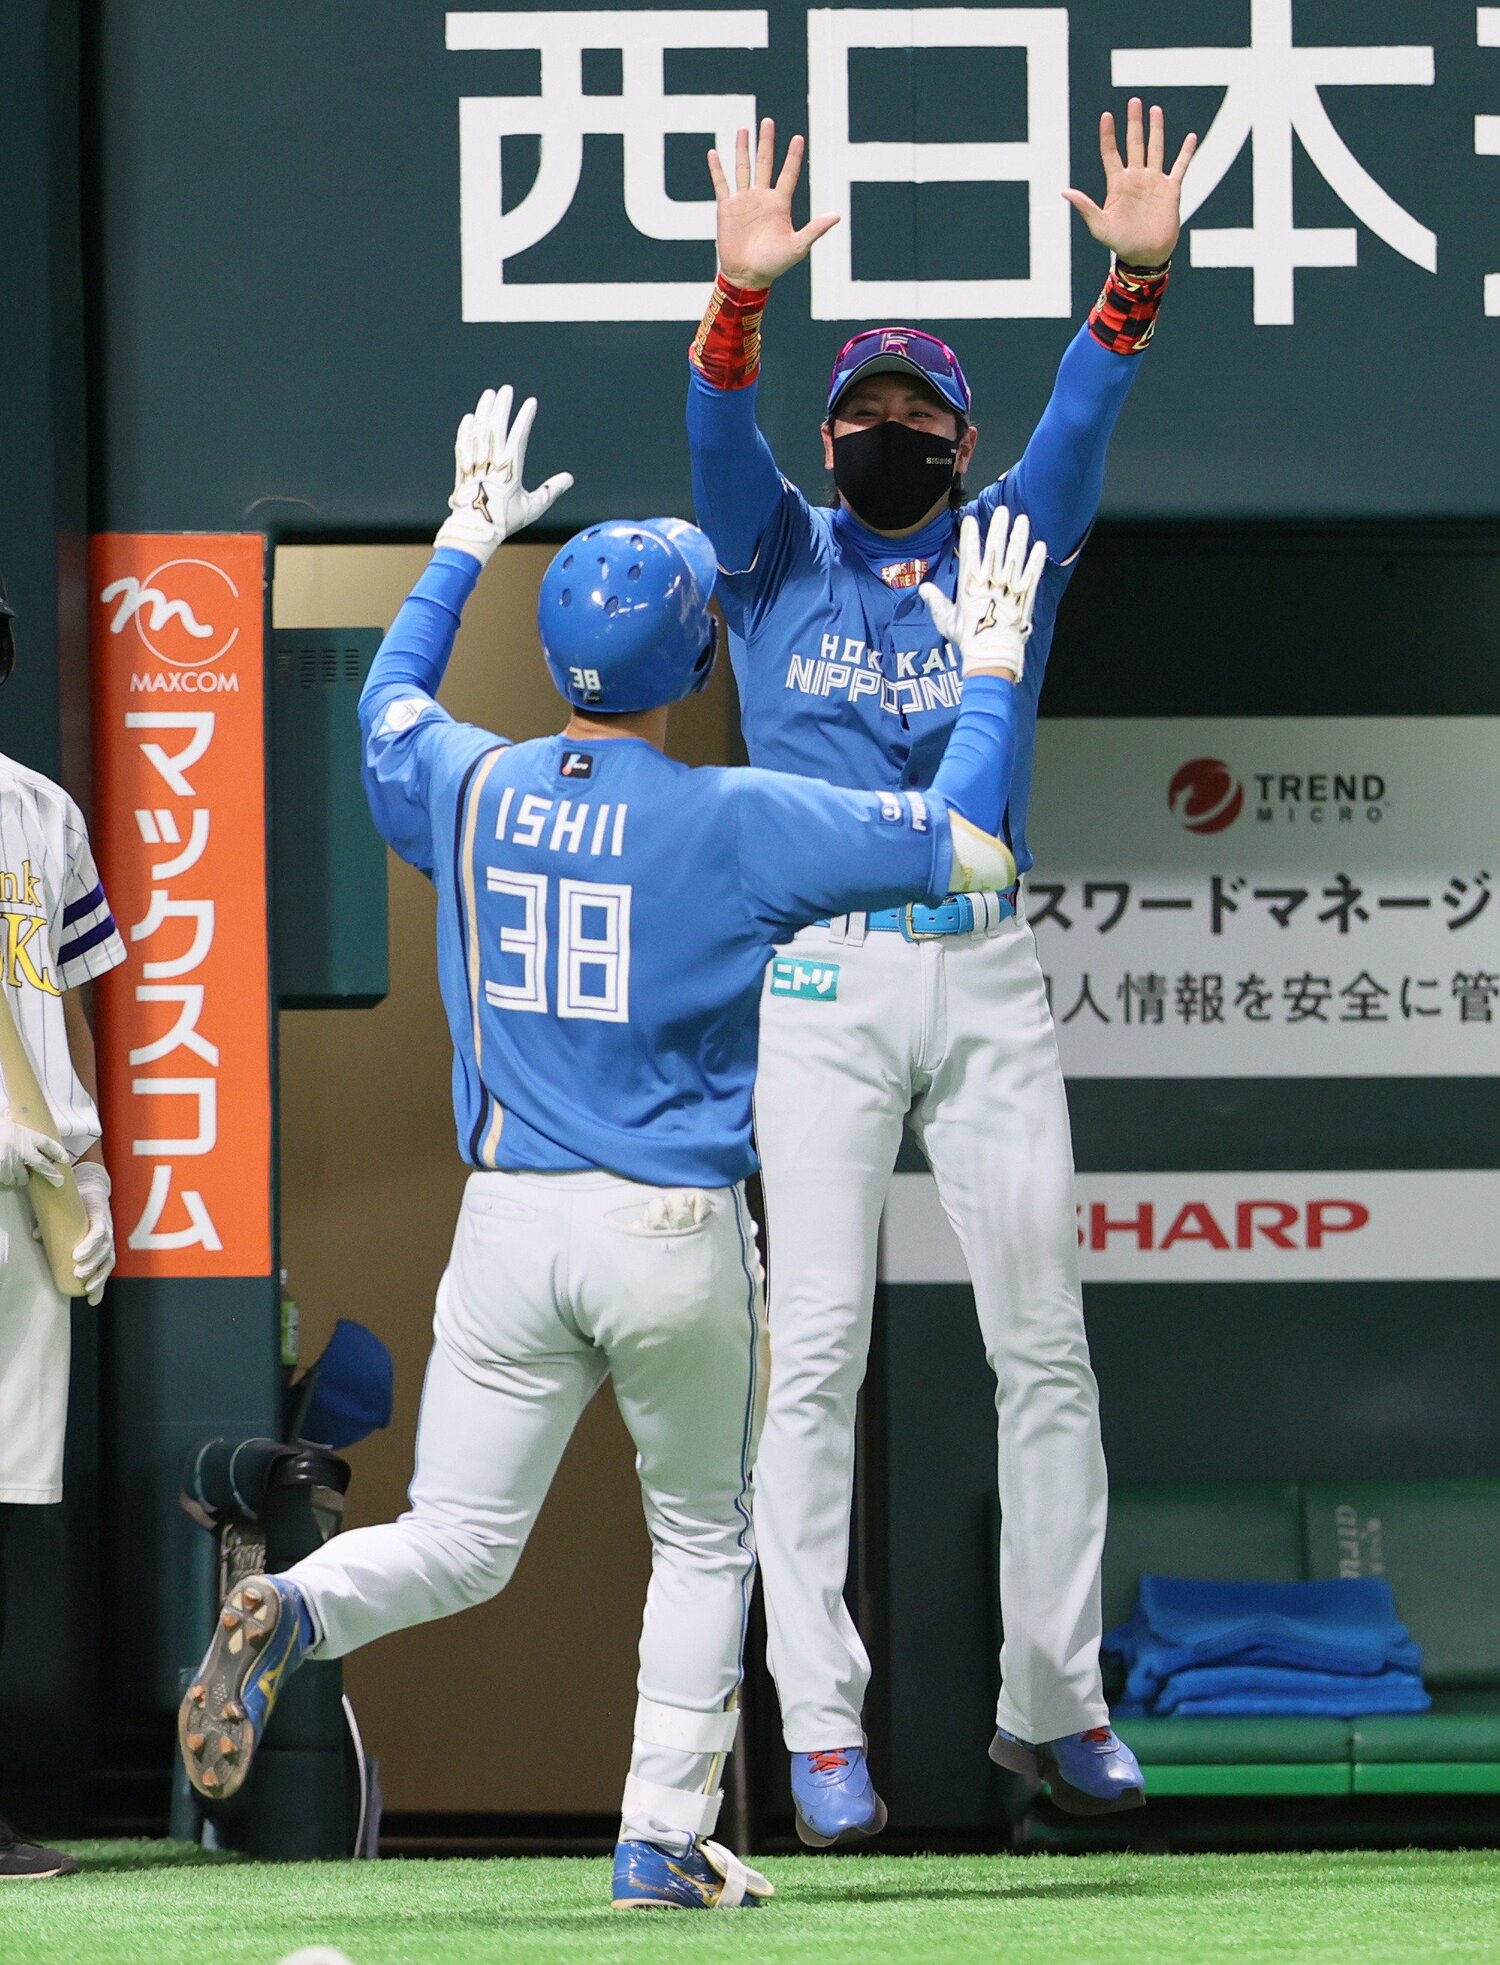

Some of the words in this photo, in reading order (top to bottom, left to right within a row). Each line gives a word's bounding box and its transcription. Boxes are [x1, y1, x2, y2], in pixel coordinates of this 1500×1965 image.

[446, 0, 1500, 325] 西日本
[129, 671, 240, 693] MAXCOM
[569, 666, 601, 691] 38
[1254, 774, 1386, 802] TREND
[1256, 805, 1383, 824] MICRO
[495, 787, 628, 857] ISHII
[1027, 870, 1492, 935] スワードマネージ
[0, 911, 62, 997] K
[485, 866, 632, 1023] 38
[124, 711, 223, 1251] マックスコム
[774, 963, 834, 995] ニトリ
[1043, 970, 1499, 1025] 人情報を安全に管
[1076, 1199, 1370, 1251] HARP
